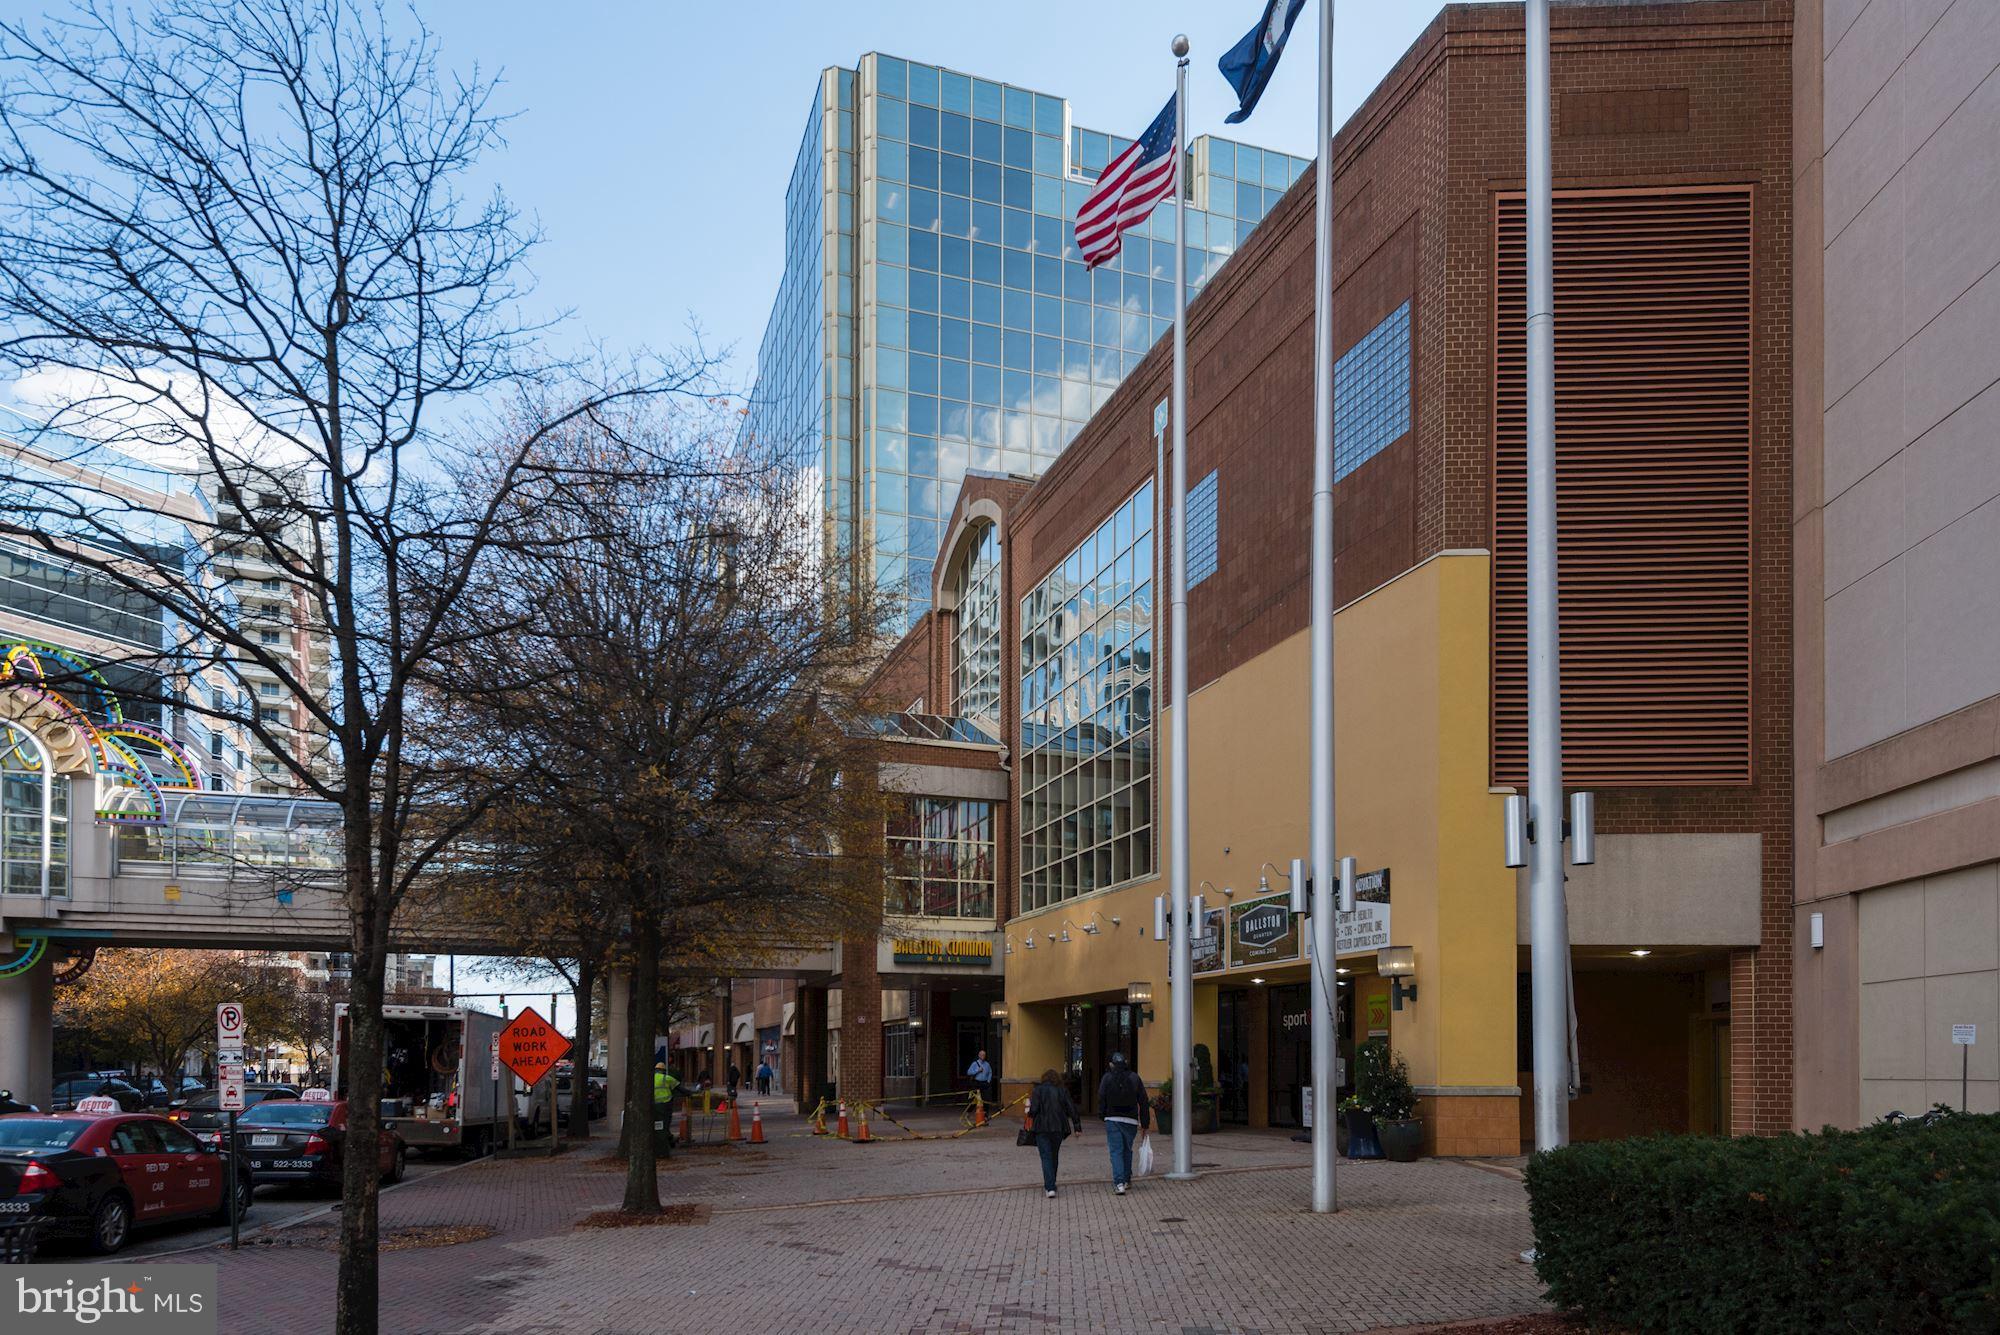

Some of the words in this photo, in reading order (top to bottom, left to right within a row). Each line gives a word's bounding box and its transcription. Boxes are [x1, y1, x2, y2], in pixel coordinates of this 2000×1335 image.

[1245, 914, 1281, 933] BALLSTON
[1252, 931, 1273, 940] QUARTER
[893, 938, 942, 955] BALLSTON
[945, 939, 992, 957] COMMON
[1248, 947, 1266, 957] COMING
[513, 1026, 546, 1037] ROAD
[513, 1042, 547, 1051] WORK
[512, 1056, 550, 1066] AHEAD
[273, 1160, 313, 1168] 522-3333
[152, 1181, 165, 1192] CAB
